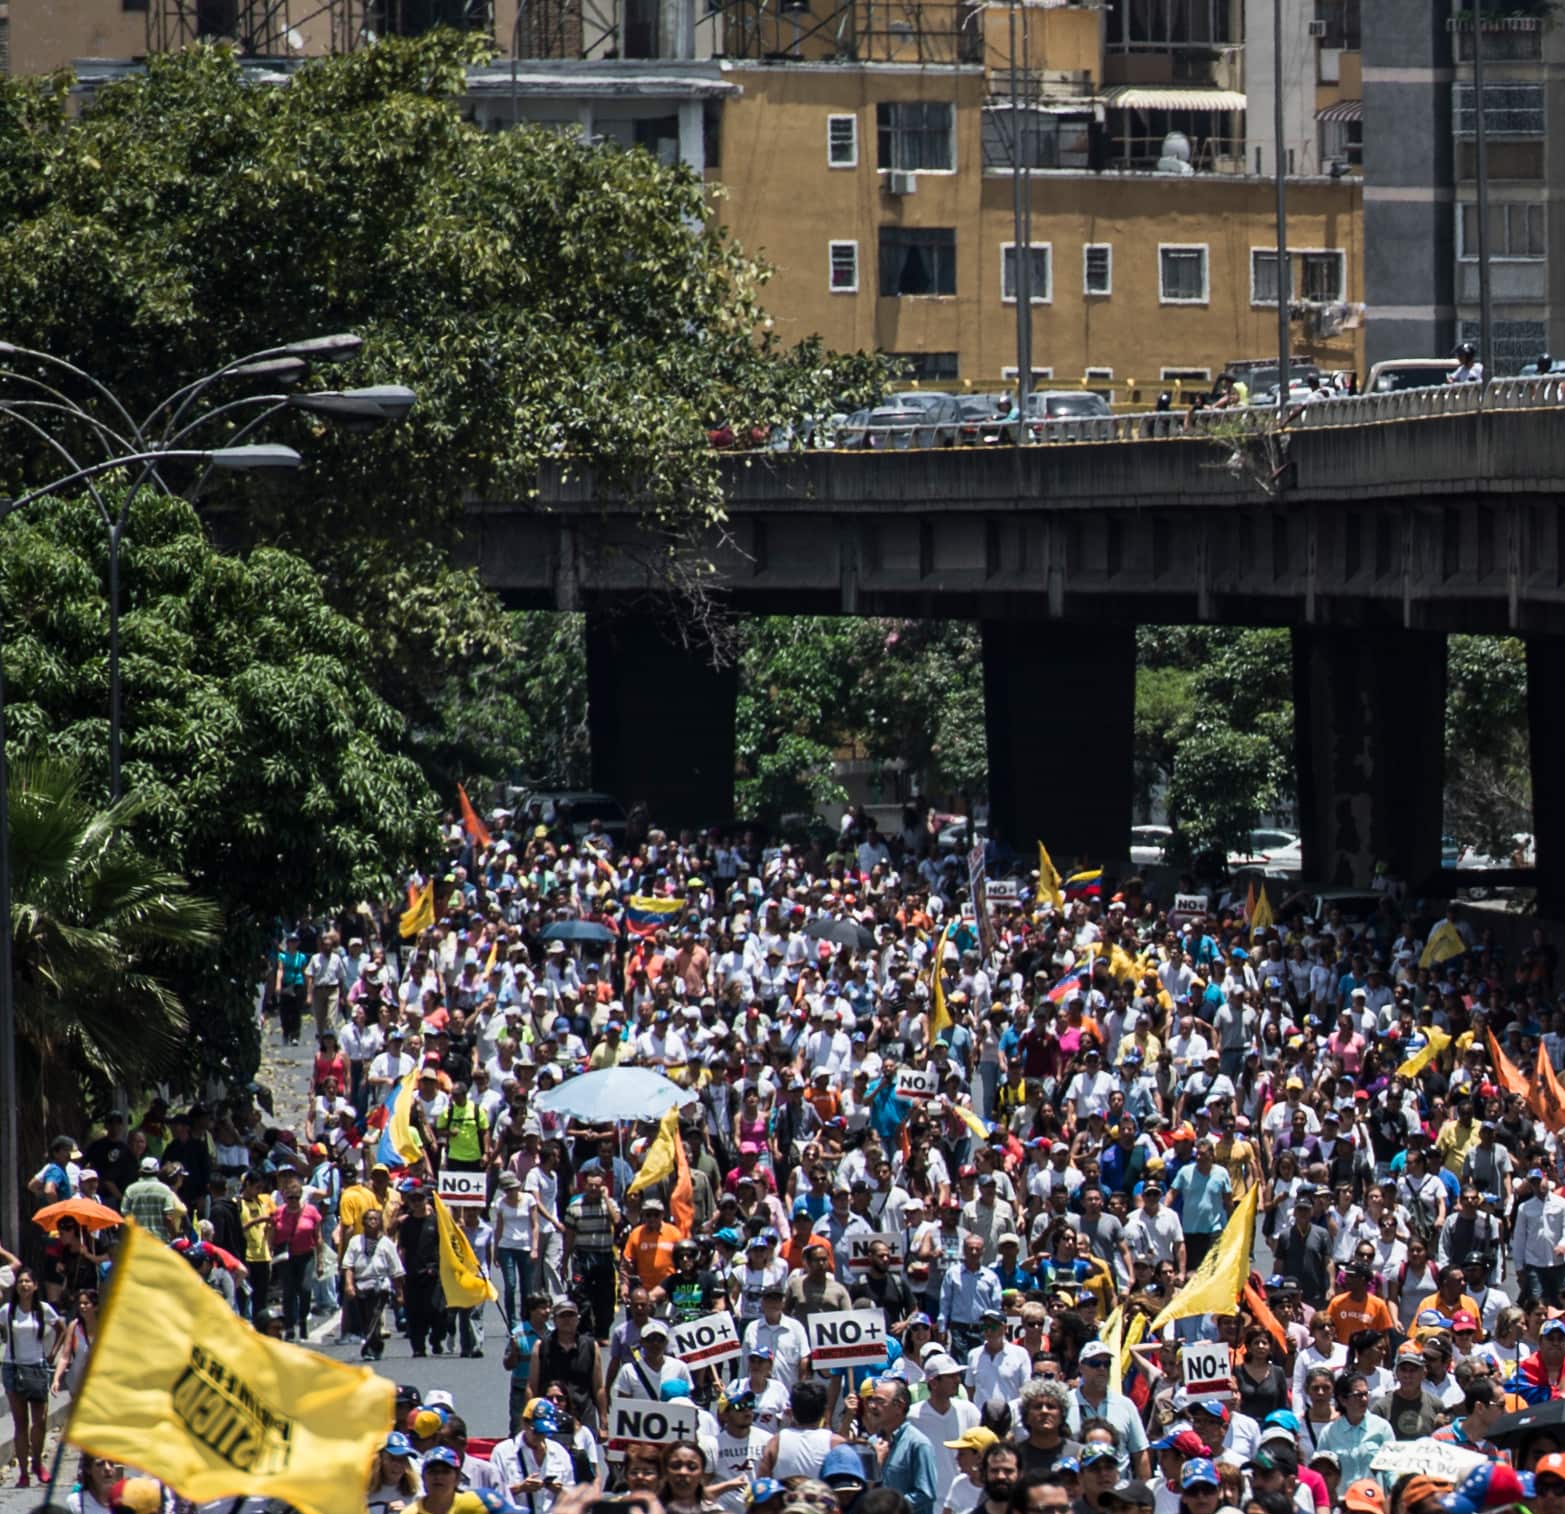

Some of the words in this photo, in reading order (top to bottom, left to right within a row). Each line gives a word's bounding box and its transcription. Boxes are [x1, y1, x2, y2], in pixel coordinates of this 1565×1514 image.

[901, 1075, 936, 1090] NO+
[443, 1177, 483, 1192] NO+
[853, 1241, 899, 1257] N+
[675, 1324, 732, 1353] NO+
[816, 1319, 882, 1345] NO+
[1187, 1354, 1229, 1380] NO+
[617, 1409, 691, 1440] NO+
